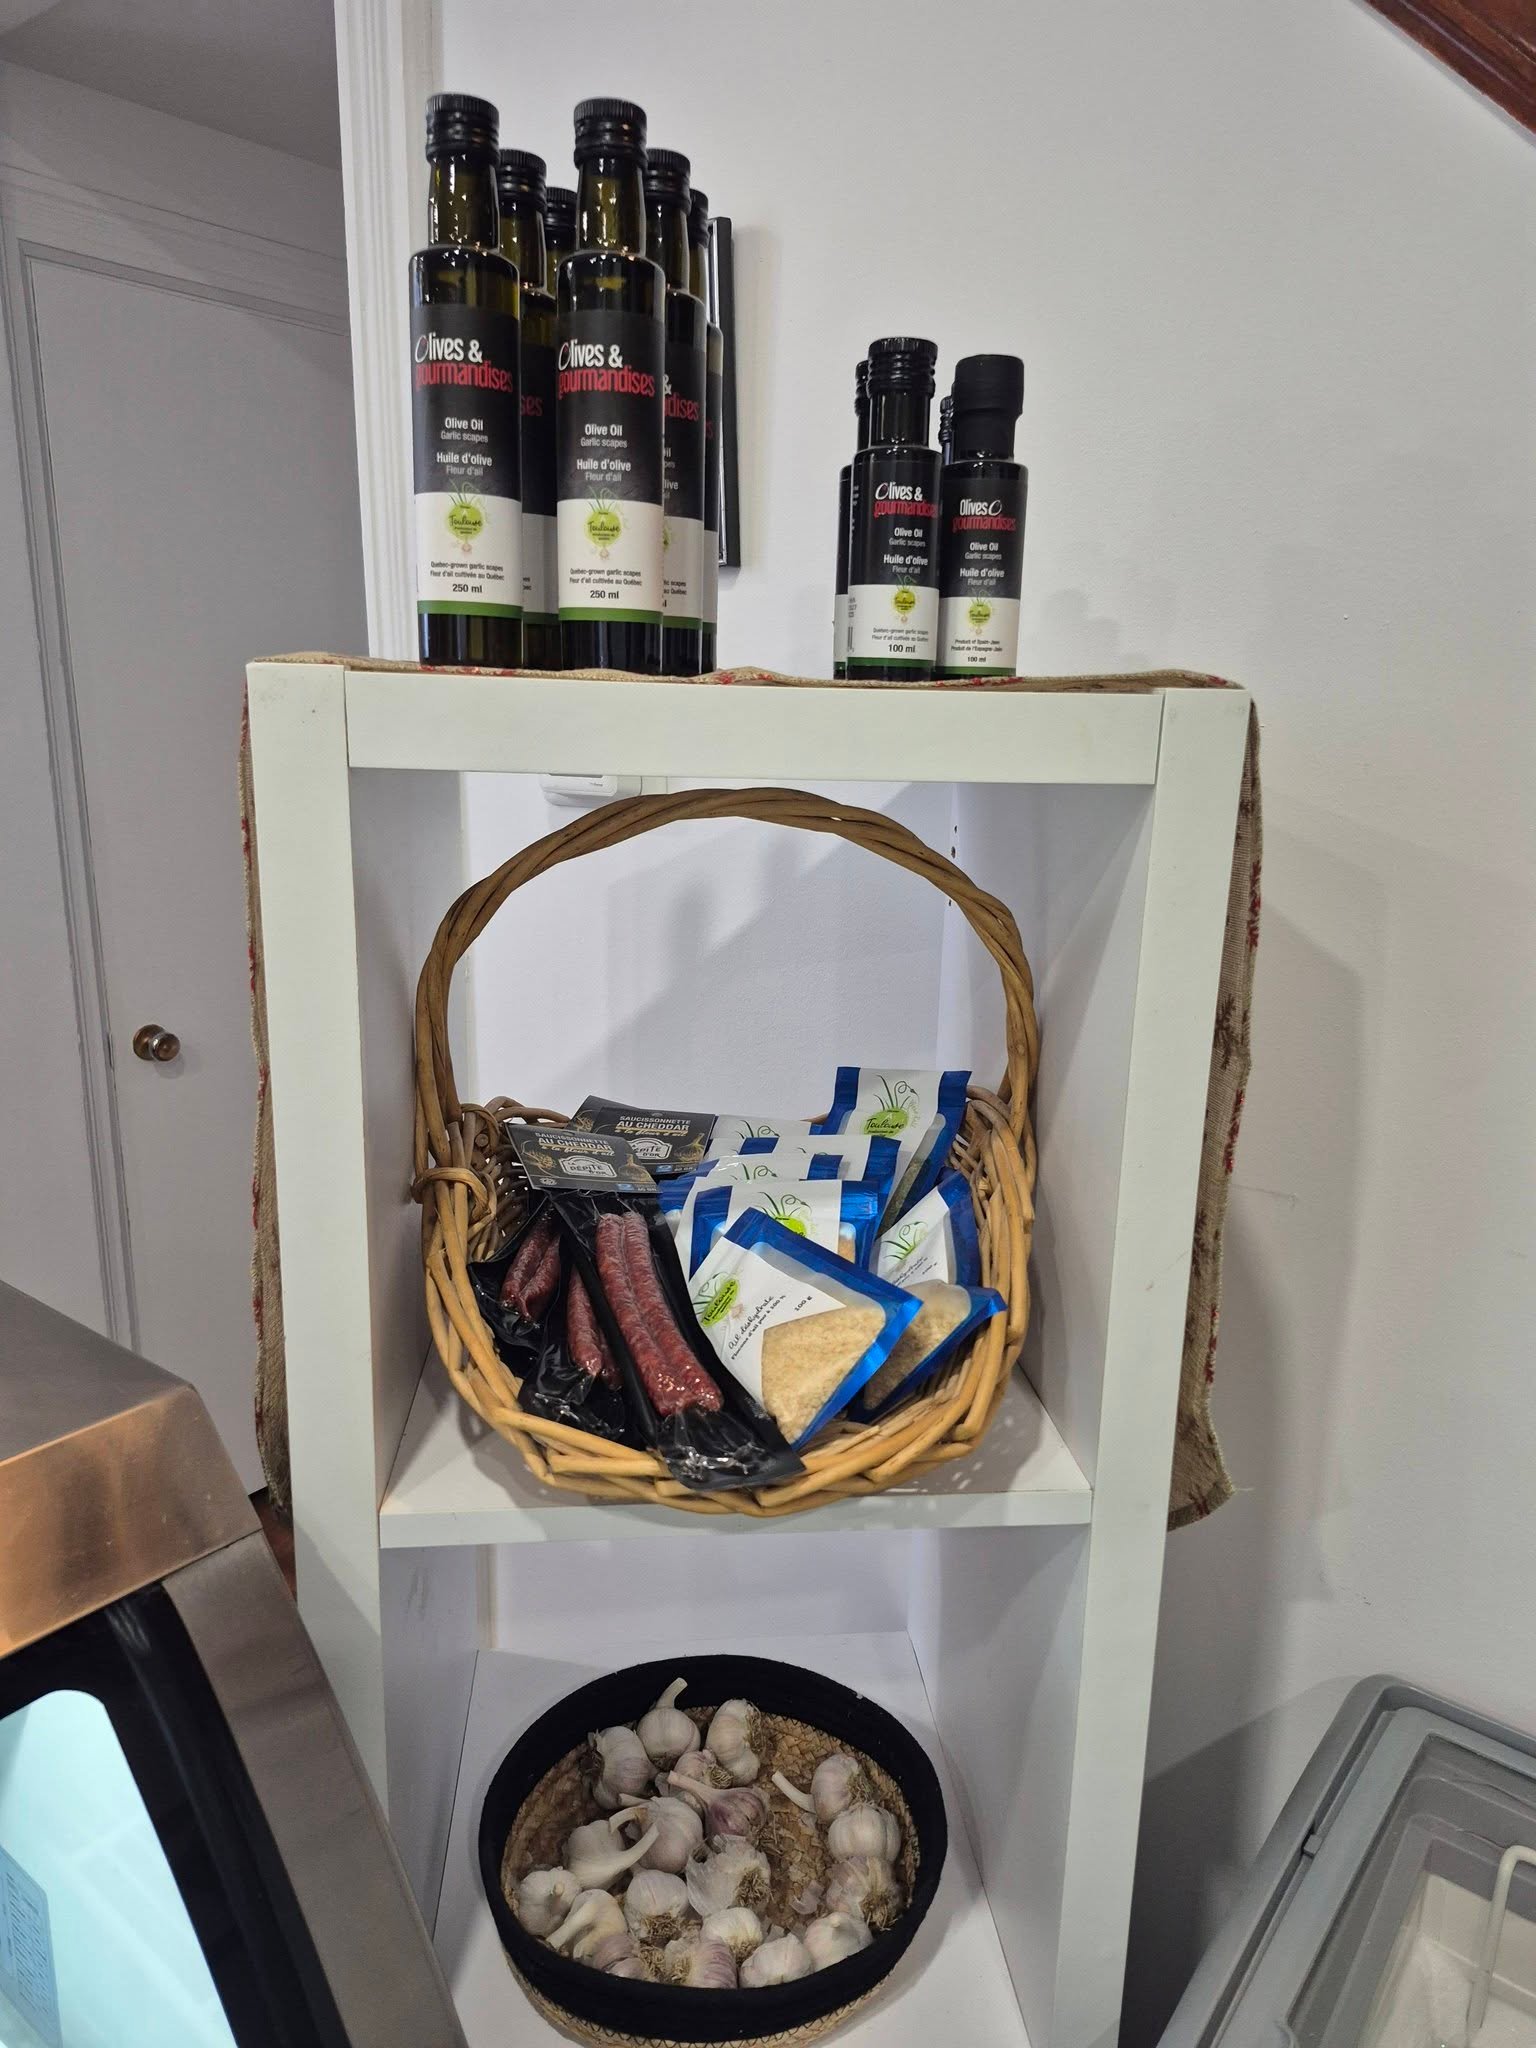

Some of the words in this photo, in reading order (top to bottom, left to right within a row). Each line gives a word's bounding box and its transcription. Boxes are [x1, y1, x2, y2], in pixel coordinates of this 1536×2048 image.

[415, 332, 464, 363] Olives
[468, 339, 483, 363] &
[558, 338, 604, 371] Olives
[608, 344, 623, 368] &
[415, 361, 513, 392] gourmandises
[558, 364, 655, 400] gourmandises
[444, 417, 468, 429] Olive
[470, 418, 484, 430] Oil
[584, 424, 608, 436] Olive
[610, 424, 623, 436] Oil
[440, 430, 462, 440] Garlic
[462, 432, 488, 443] scapes
[580, 438, 600, 447] Garlic
[602, 438, 628, 448] scapes
[436, 452, 460, 464] Huile
[462, 452, 492, 466] d'olive
[446, 465, 465, 474] Fleur
[466, 466, 483, 476] d'ail
[576, 459, 598, 470] Huile
[600, 459, 632, 472] d'olive
[585, 472, 604, 480] Fleur
[606, 472, 622, 482] d'ail
[875, 481, 913, 500] Olives
[914, 486, 922, 501] &
[588, 520, 620, 532] Toulouse
[894, 528, 912, 536] Olive
[914, 528, 922, 538] Oil
[970, 542, 988, 550] Olive
[988, 542, 999, 551] Oil
[884, 554, 904, 564] Huile
[906, 555, 928, 566] d'olive
[960, 568, 980, 577] Huile
[980, 568, 1004, 578] d'olive
[452, 584, 469, 592] 250
[471, 584, 483, 593] ml
[590, 590, 606, 598] 250
[608, 590, 620, 600] ml
[889, 644, 904, 652] 100
[905, 644, 916, 652] ml
[620, 1116, 691, 1125] SAUCISSONNETTE
[636, 1122, 690, 1131] CHEDDAR
[866, 1117, 904, 1130] Toulouse
[535, 1132, 609, 1145] SAUCISSONNETTE
[538, 1137, 556, 1146] AU
[556, 1139, 613, 1151] CHEDDAR
[794, 1300, 807, 1312] 100
[728, 1334, 742, 1350] Ail
